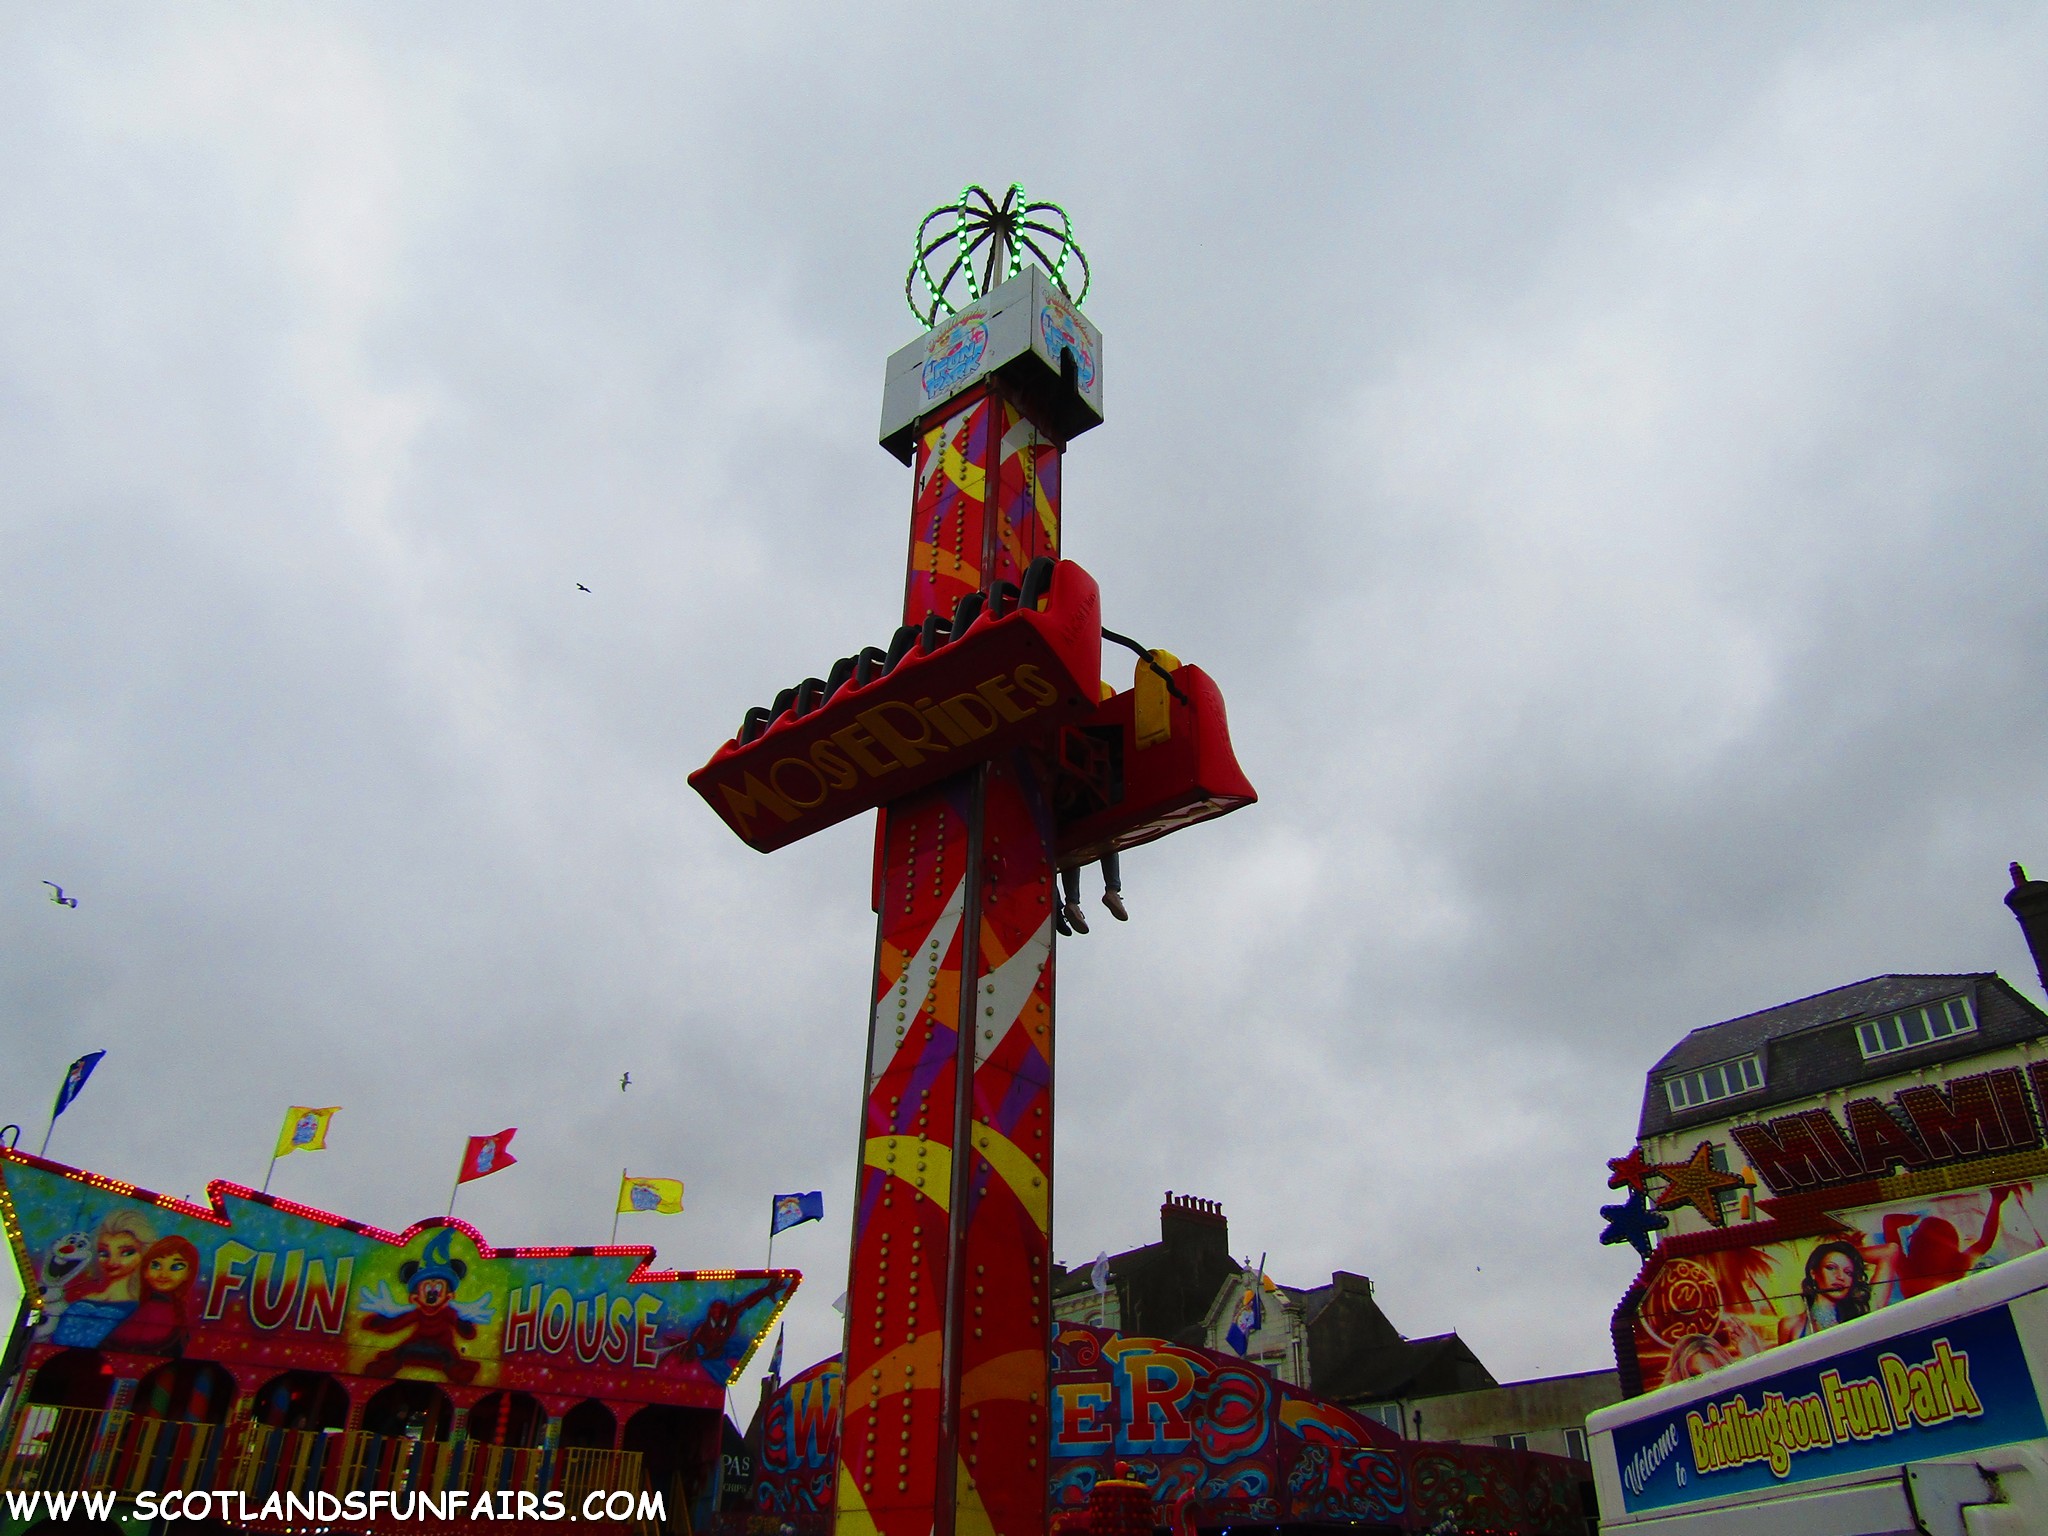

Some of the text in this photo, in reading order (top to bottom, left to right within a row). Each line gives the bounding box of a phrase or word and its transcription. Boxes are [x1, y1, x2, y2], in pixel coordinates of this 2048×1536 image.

[1729, 1066, 2043, 1197] MIAMI
[203, 1241, 665, 1370] FUN HOUSE
[1623, 1421, 1680, 1496] Welcome
[1685, 1337, 1985, 1479] Bridlington Fun Park
[1676, 1461, 1688, 1489] to
